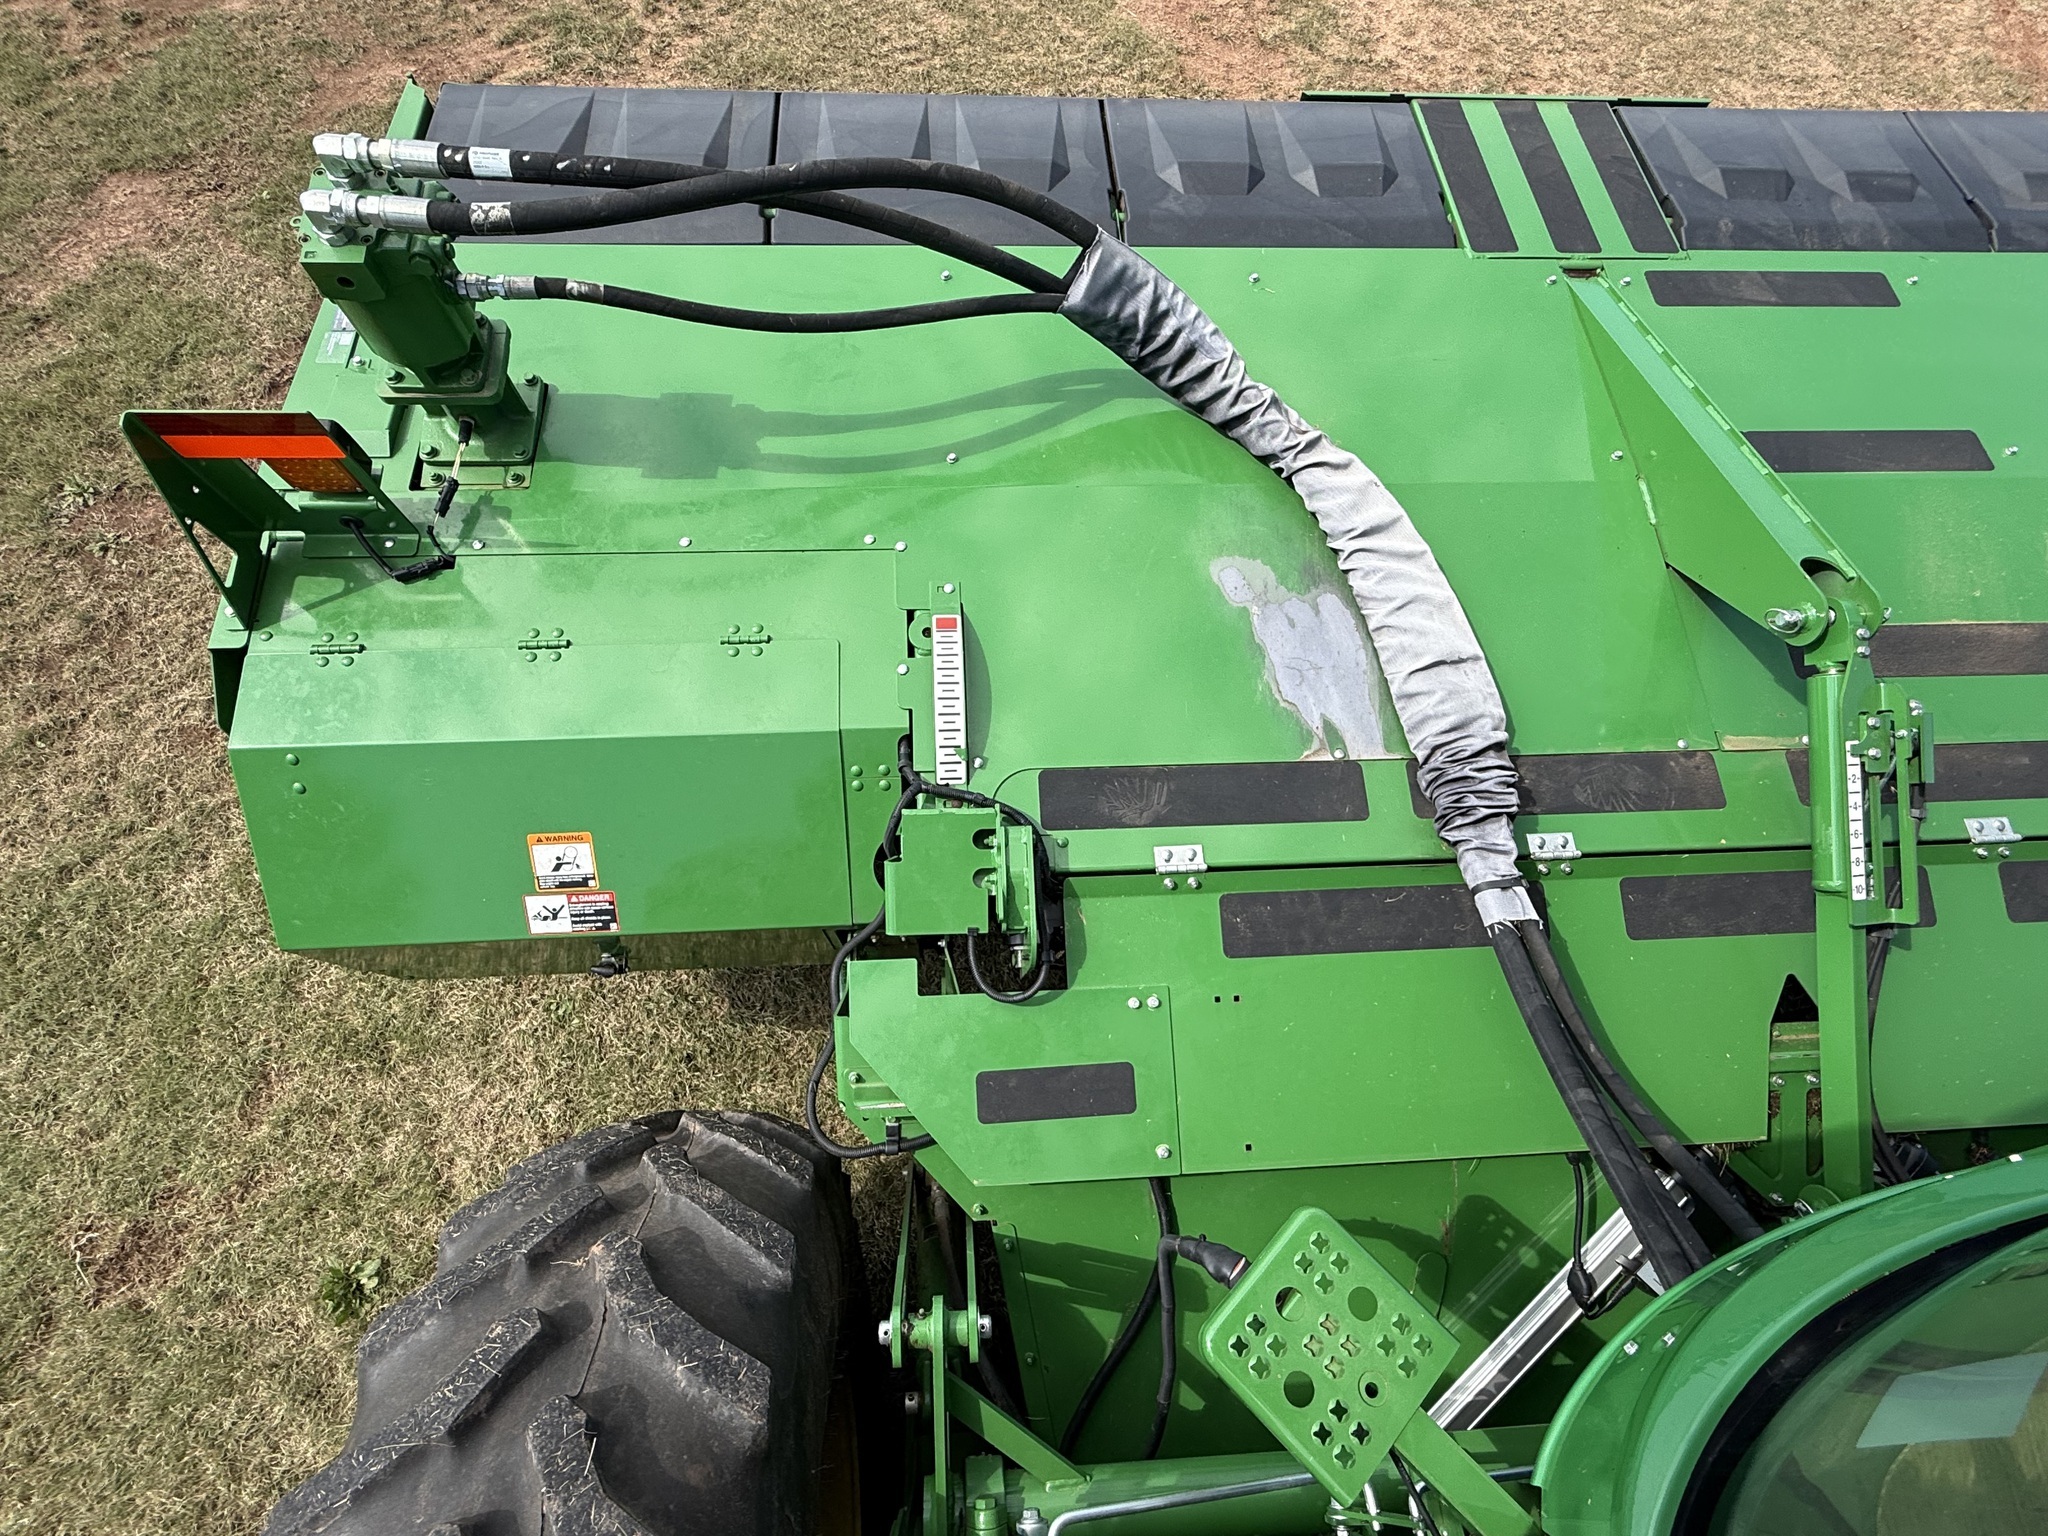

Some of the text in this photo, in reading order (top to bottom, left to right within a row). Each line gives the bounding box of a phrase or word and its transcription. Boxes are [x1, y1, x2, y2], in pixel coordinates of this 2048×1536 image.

[1851, 774, 1857, 784] 2
[1852, 801, 1858, 811] 4
[545, 834, 584, 842] WARNING
[1853, 829, 1859, 839] 6
[1855, 857, 1861, 867] 8
[1855, 884, 1863, 895] 10
[579, 894, 610, 902] DANGER
